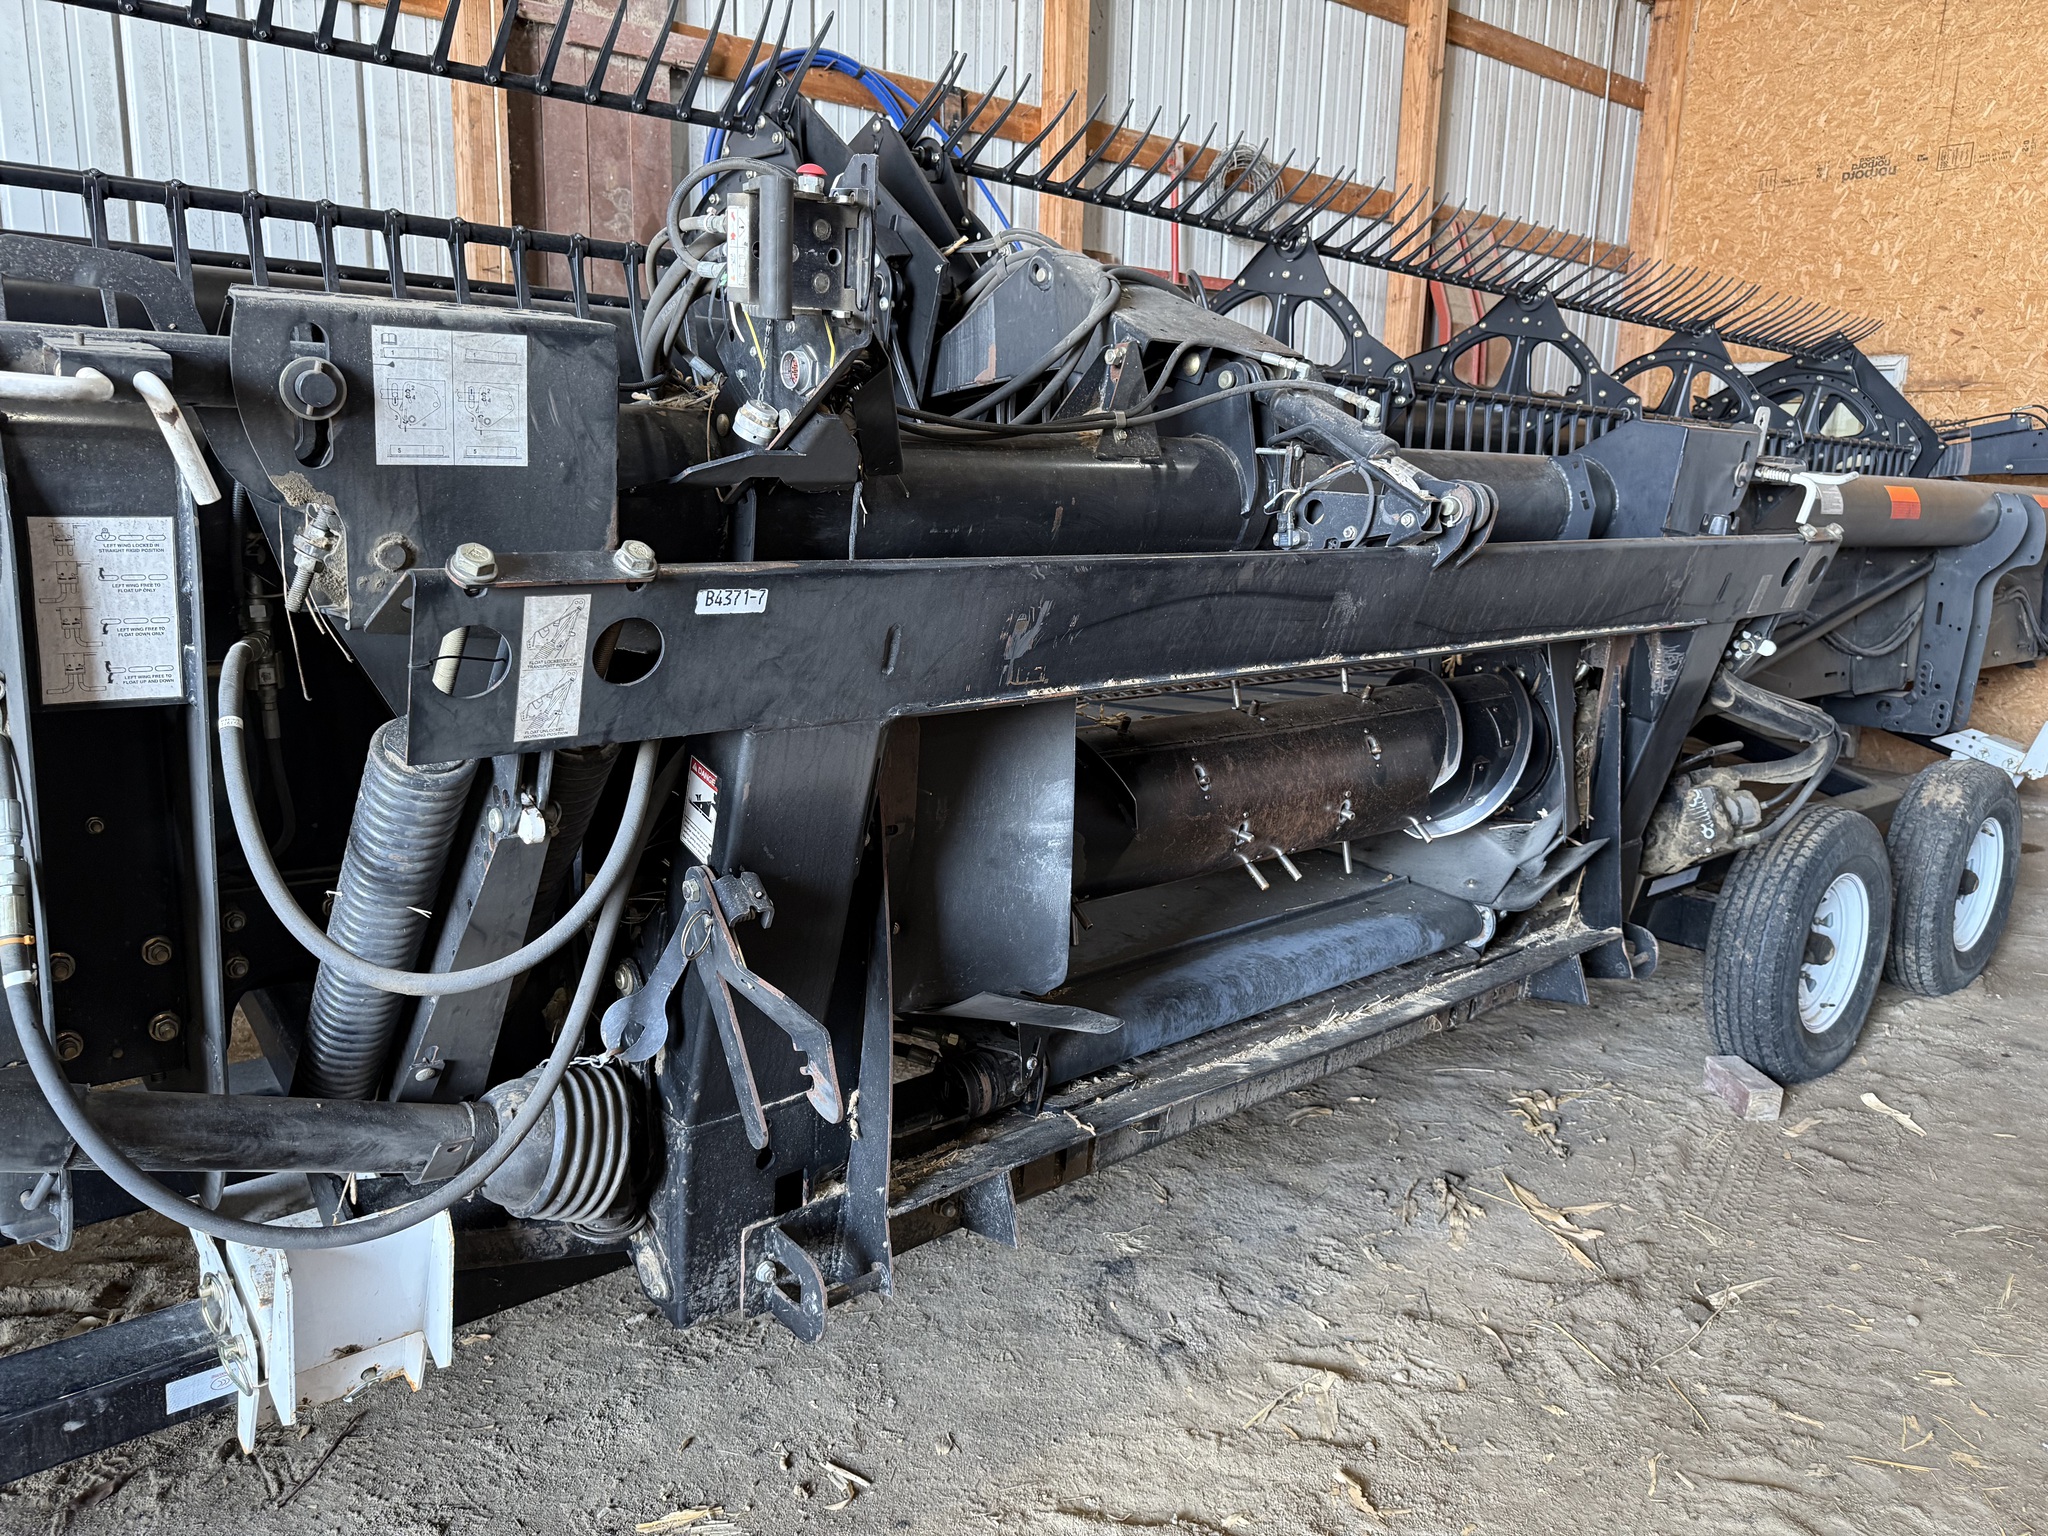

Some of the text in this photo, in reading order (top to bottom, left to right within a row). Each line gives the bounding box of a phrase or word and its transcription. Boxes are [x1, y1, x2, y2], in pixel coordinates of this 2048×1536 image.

[1842, 165, 1898, 183] norbord
[1851, 159, 1891, 176] norbord
[705, 589, 766, 606] B4371-7
[697, 766, 716, 786] DANGE
